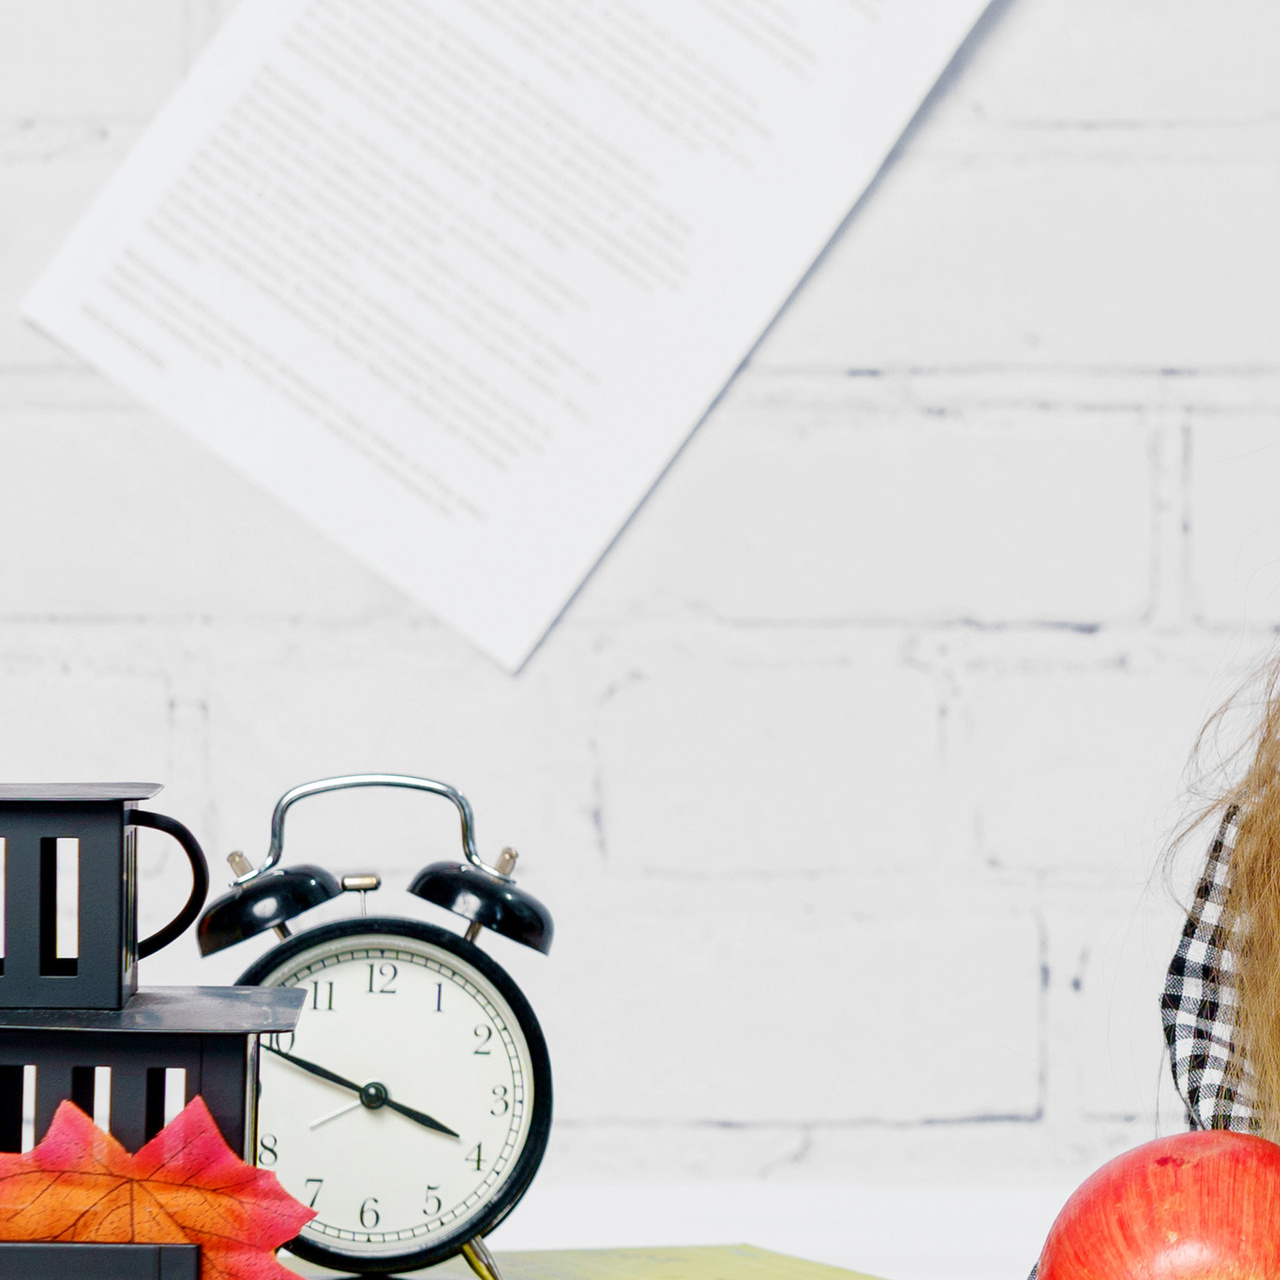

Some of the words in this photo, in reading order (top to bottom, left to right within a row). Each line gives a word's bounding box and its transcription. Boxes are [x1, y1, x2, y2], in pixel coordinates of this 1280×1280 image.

[366, 962, 398, 994] 12
[309, 980, 336, 1011] 11
[433, 982, 444, 1012] 1
[473, 1023, 493, 1055] 2
[489, 1084, 508, 1116] 3
[258, 1133, 279, 1166] 8
[465, 1141, 487, 1171] 4
[305, 1178, 324, 1209] 7
[422, 1183, 442, 1215] 5
[359, 1197, 380, 1229] 6
